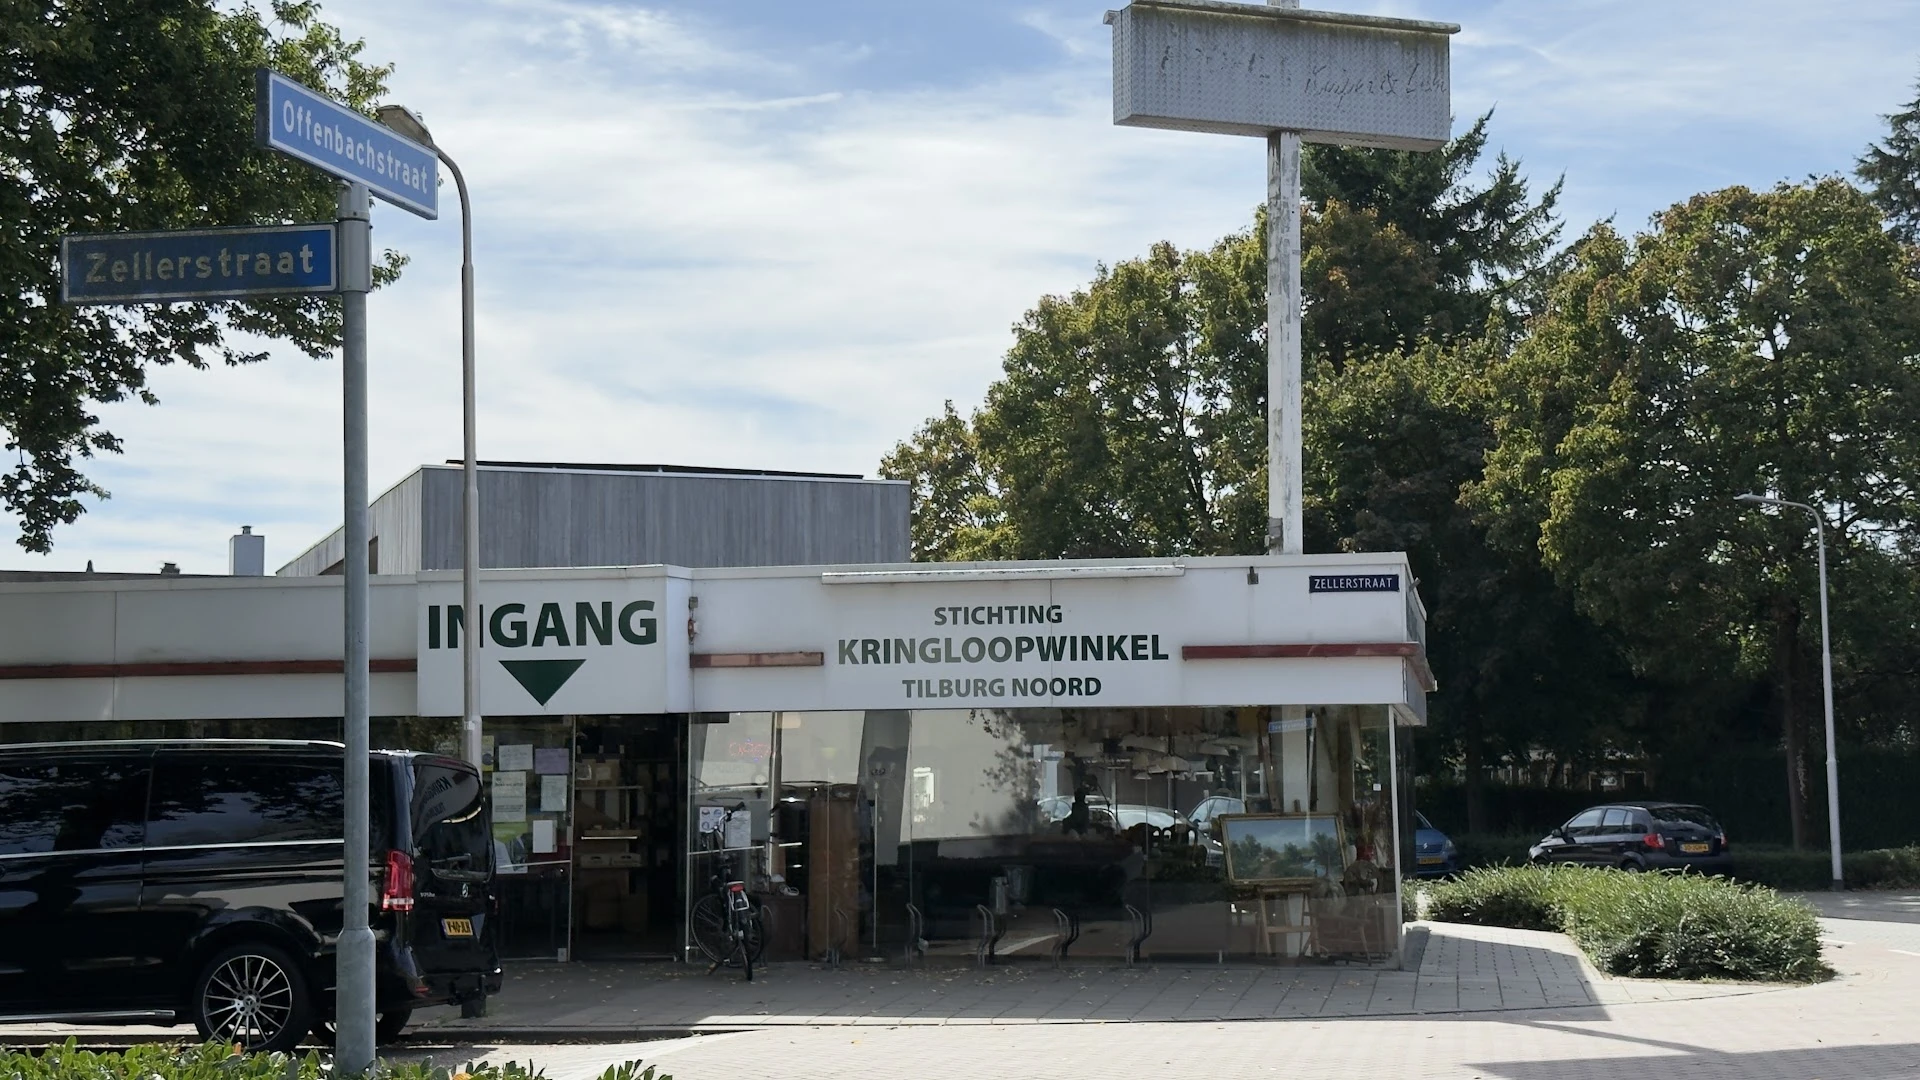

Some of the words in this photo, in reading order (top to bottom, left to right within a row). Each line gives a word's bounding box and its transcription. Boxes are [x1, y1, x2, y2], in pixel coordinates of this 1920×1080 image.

[282, 99, 428, 195] Offenbachstraat
[85, 244, 314, 283] Zellerstraat
[1314, 577, 1392, 589] ZELLERSTRAAT
[428, 600, 657, 649] INGANG
[934, 605, 1063, 626] STICHTING
[838, 634, 1169, 665] KRINGLOOPWINKEL
[902, 677, 1005, 698] TILBURG
[1012, 677, 1102, 697] NOORD
